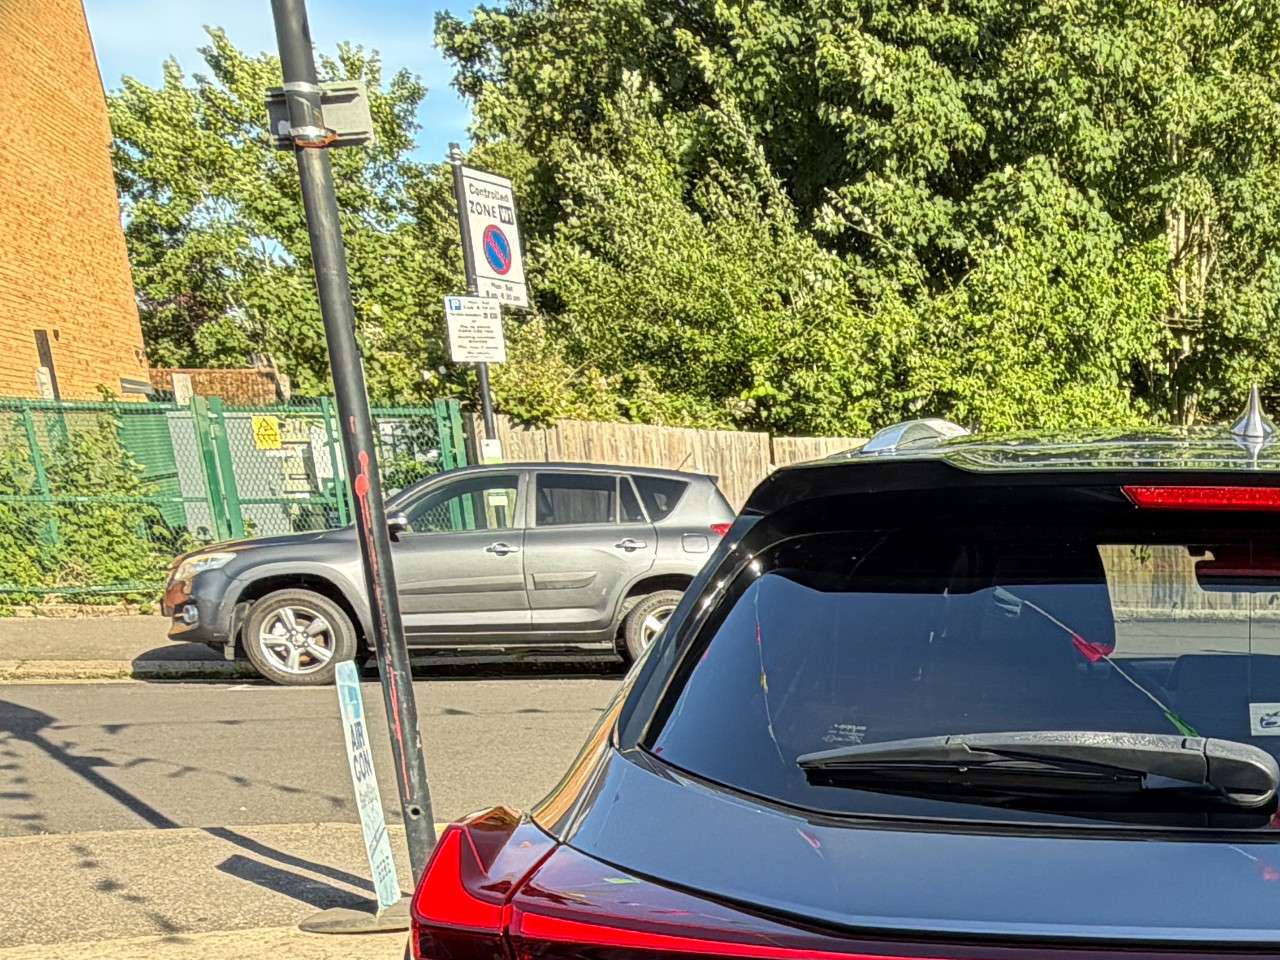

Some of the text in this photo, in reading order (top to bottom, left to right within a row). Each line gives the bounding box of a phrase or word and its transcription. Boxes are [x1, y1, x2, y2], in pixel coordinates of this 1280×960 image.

[469, 183, 509, 202] Controlled
[468, 200, 498, 219] ZONE
[350, 721, 365, 751] AIR
[353, 751, 371, 783] CON
